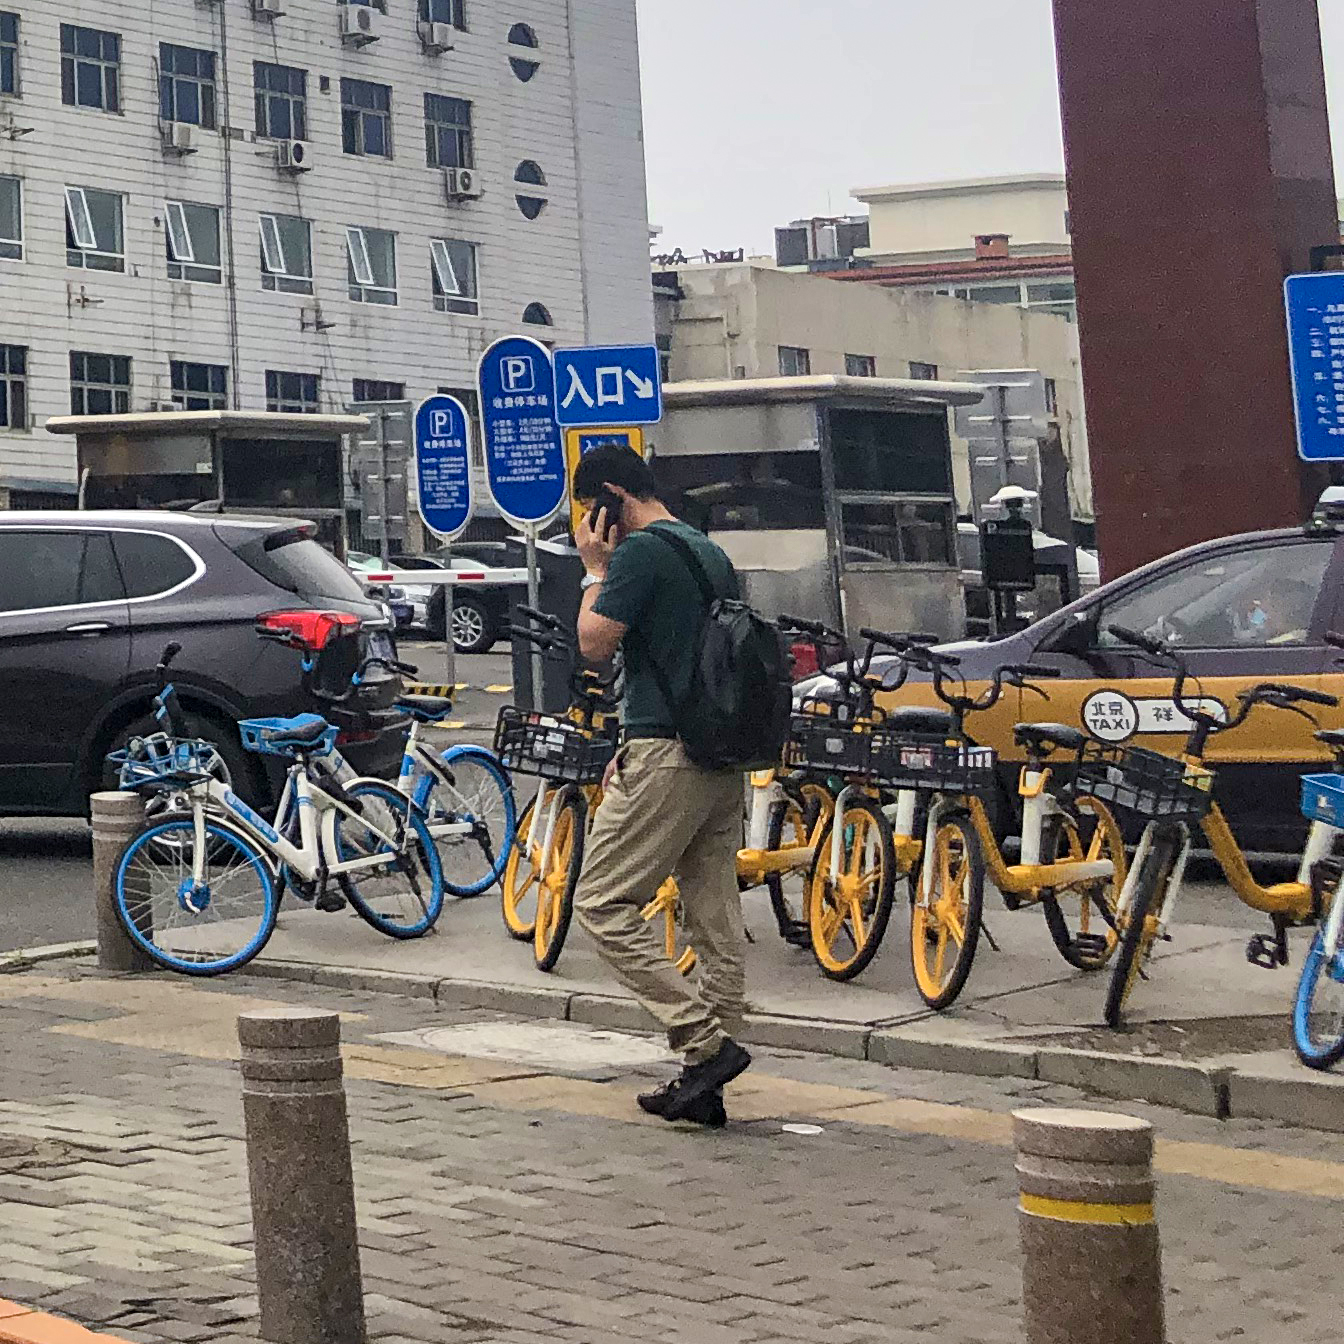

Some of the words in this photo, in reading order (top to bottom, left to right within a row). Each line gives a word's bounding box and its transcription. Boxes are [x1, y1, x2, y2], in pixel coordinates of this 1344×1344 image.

[507, 360, 526, 389] P
[560, 363, 625, 409] 入口
[434, 411, 448, 435] P
[1090, 701, 1124, 716] 北京
[1089, 718, 1130, 731] TAXI
